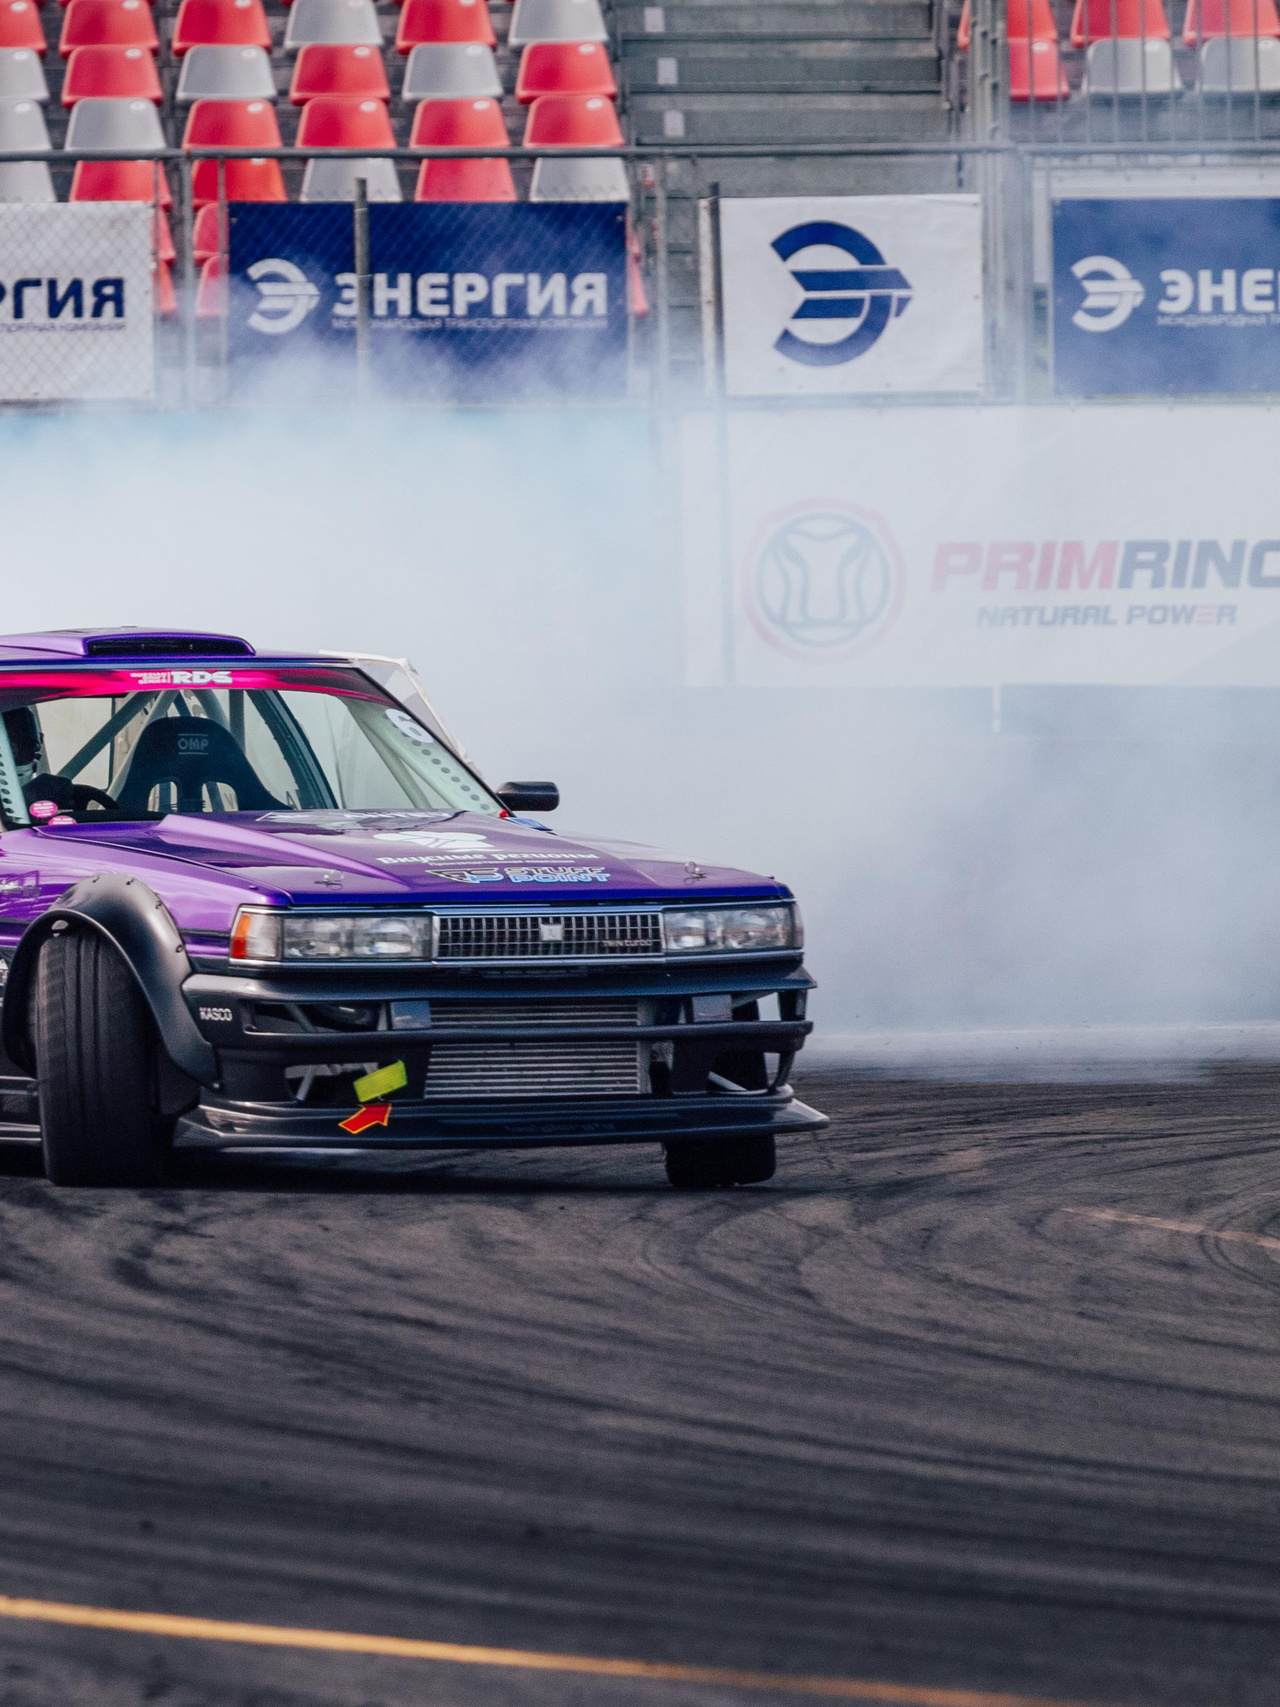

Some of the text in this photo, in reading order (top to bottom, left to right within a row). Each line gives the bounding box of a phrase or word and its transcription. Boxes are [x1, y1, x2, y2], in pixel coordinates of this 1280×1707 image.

[332, 272, 608, 318] ЭНЕРГИЯ
[1157, 268, 1280, 314] ЭНЕ
[976, 604, 1117, 627] NATURAL
[171, 670, 234, 685] RDS
[178, 737, 209, 751] OMP
